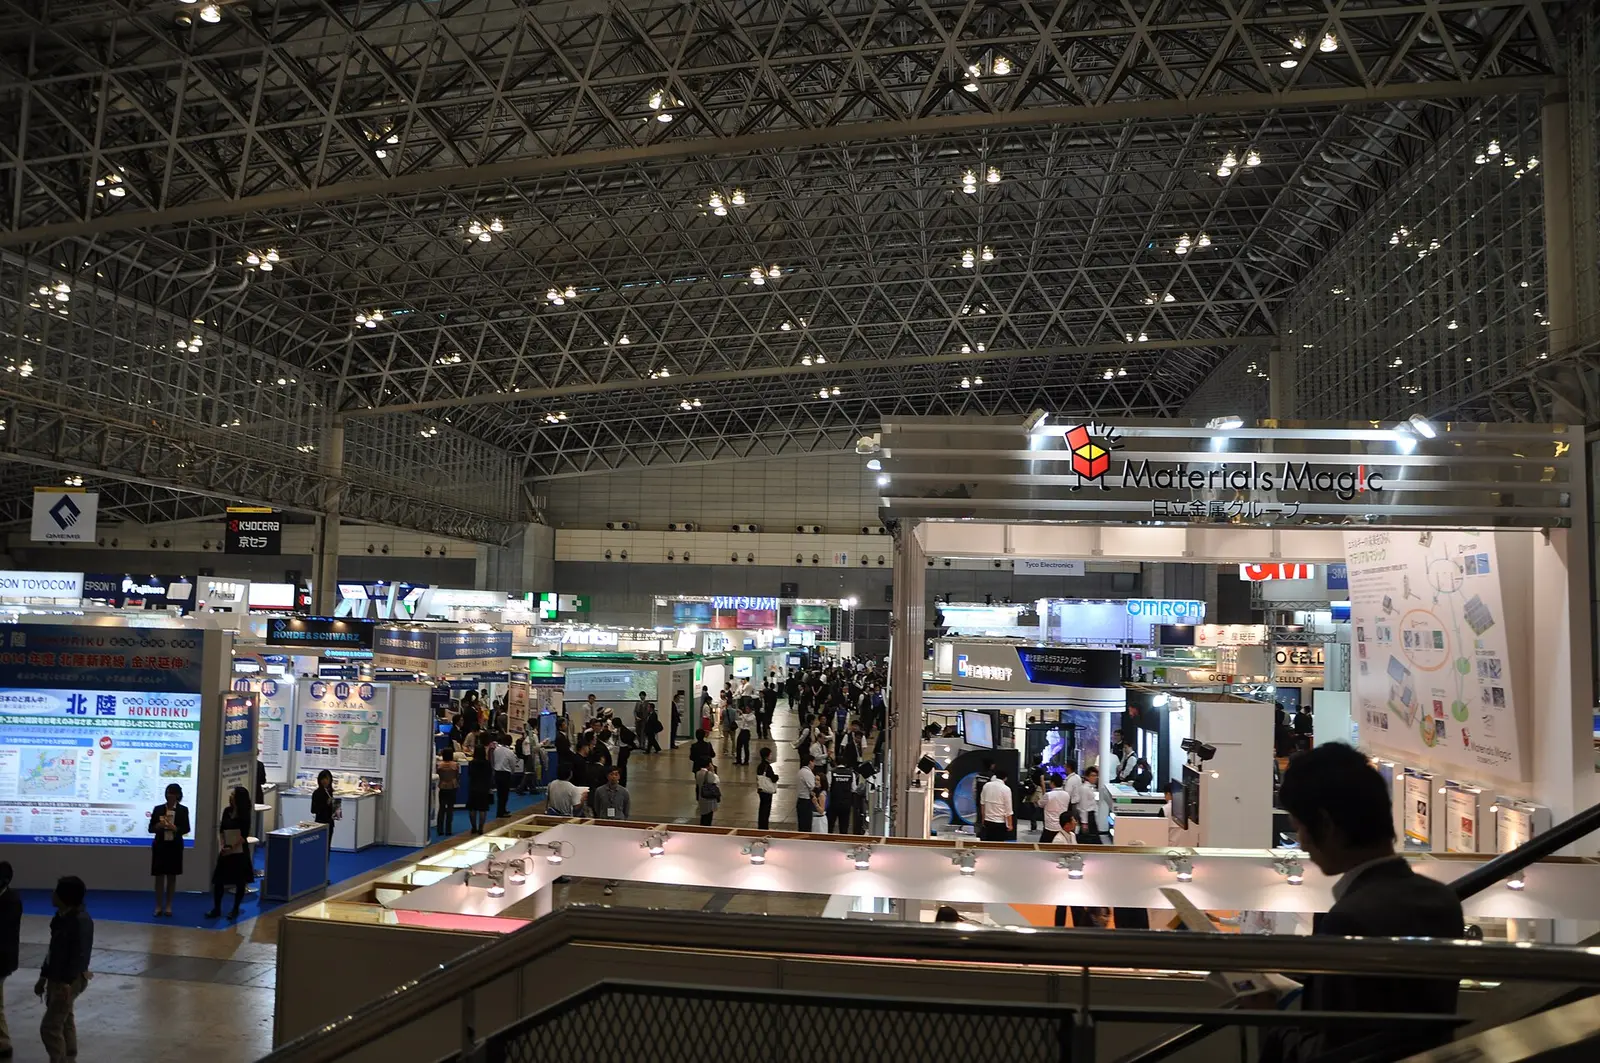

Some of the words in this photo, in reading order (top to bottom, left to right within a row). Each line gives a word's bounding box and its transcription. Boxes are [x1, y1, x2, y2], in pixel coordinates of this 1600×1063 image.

[1121, 459, 1273, 492] Materials
[1151, 500, 1300, 519] 日立金属グループ
[239, 521, 280, 531] KYOCERA
[239, 536, 268, 548] 京セラ
[1025, 561, 1039, 570] Tyco
[1040, 561, 1074, 569] Electronics
[1331, 567, 1348, 579] 3M
[22, 579, 76, 590] TOYOCOM
[84, 581, 109, 591] EPSON
[322, 700, 365, 710] TOYAMA
[129, 706, 188, 718] HOKURIKU
